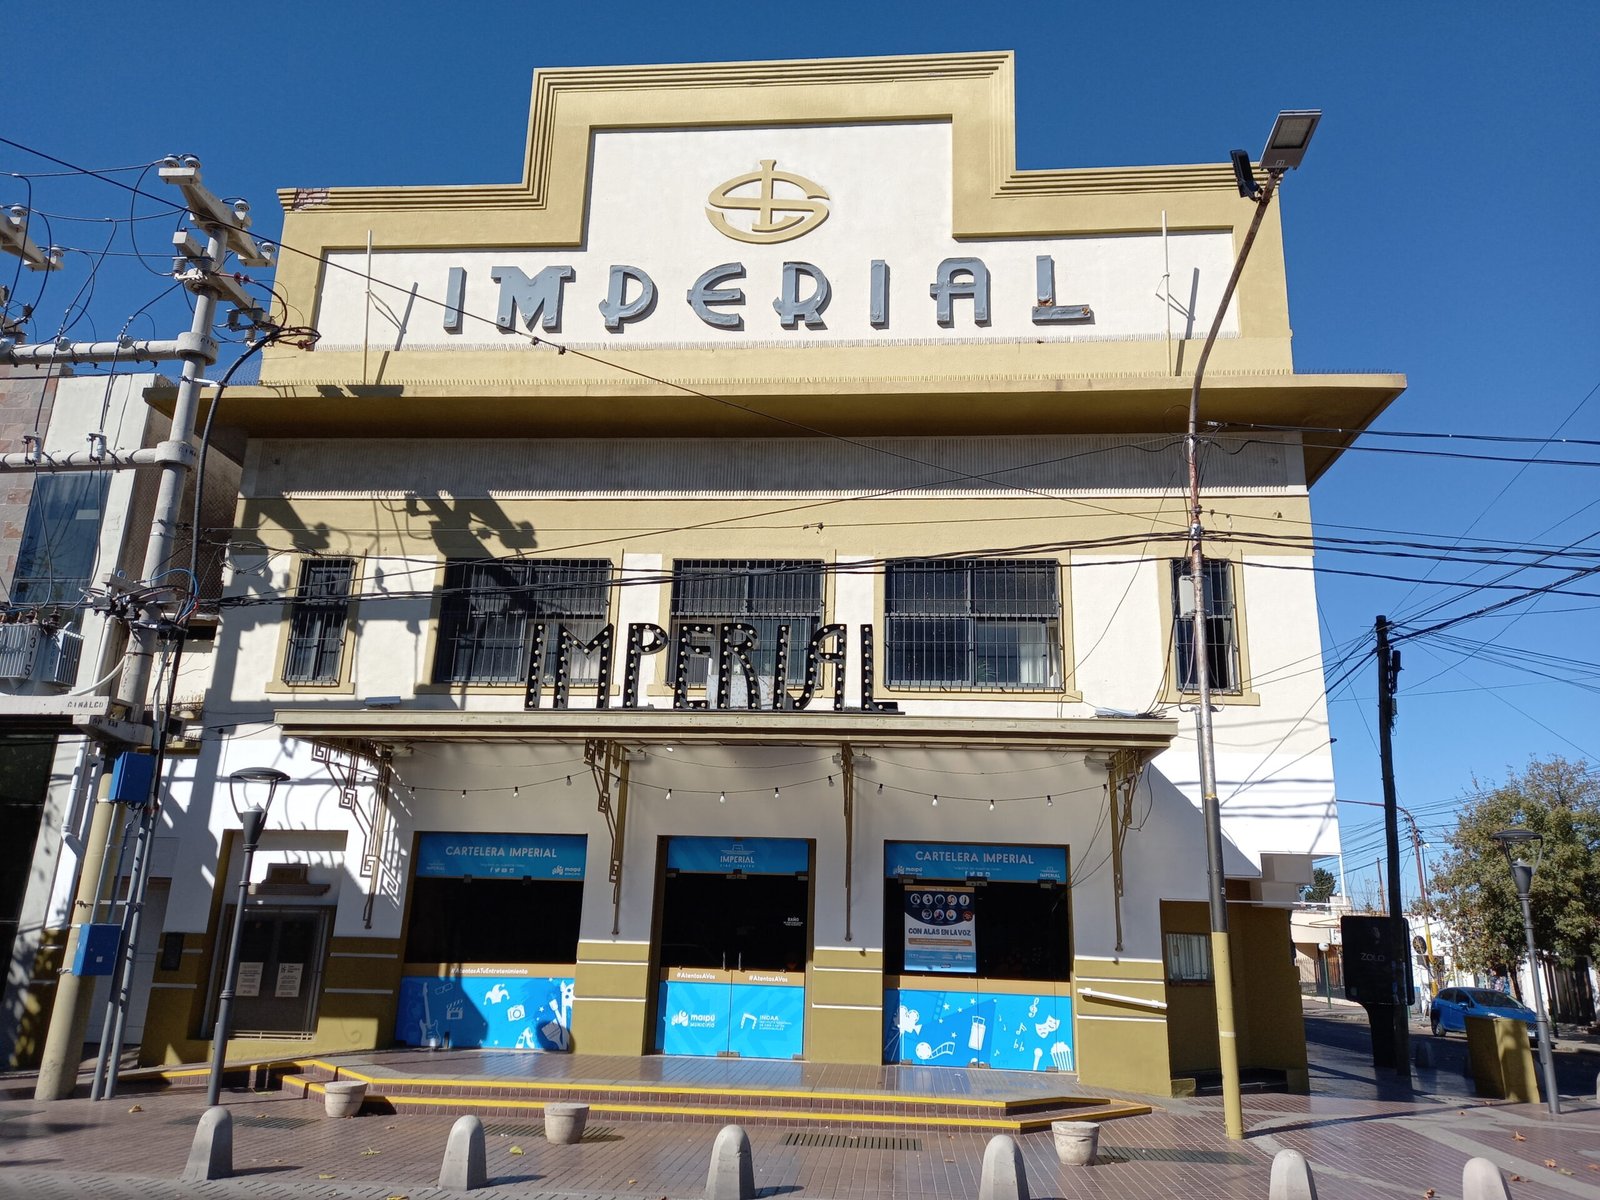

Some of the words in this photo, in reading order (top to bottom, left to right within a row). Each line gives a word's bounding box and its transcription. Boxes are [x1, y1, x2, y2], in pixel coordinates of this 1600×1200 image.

[443, 254, 1095, 334] IMPERIAL
[524, 622, 899, 711] IMPERIAL
[445, 846, 505, 857] CARTELERA
[509, 847, 558, 858] IMPERIAL
[915, 851, 979, 863] CARTELERA
[983, 853, 1034, 864] IMPERIAL
[720, 855, 755, 864] IMPERIAL
[908, 927, 922, 935] CON
[924, 928, 940, 936] ALAS
[941, 928, 949, 936] EN
[958, 929, 971, 937] VOZ
[677, 972, 715, 980] #AtentosAVos
[749, 975, 788, 983] #AtentosAVos
